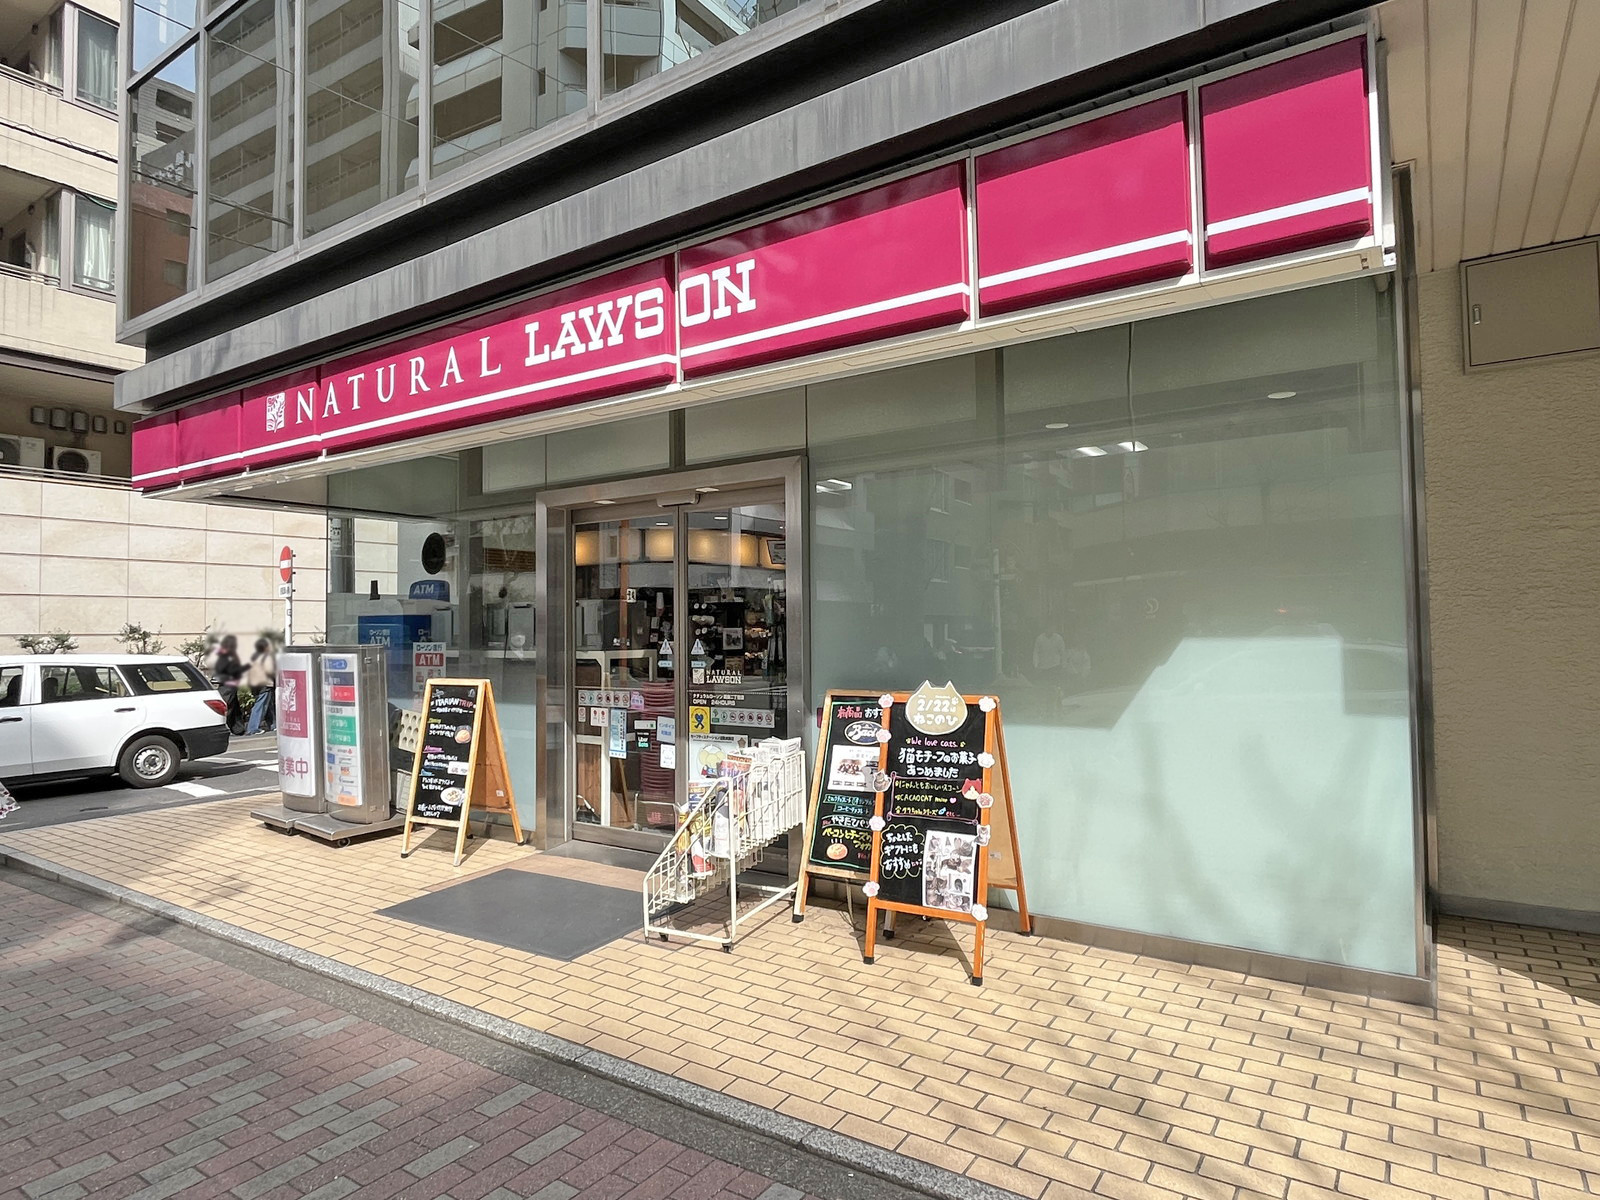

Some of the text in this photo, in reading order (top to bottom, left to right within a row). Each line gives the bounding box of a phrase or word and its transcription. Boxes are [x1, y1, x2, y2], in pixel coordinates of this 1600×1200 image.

[295, 259, 757, 425] NATURAL LAWSON
[413, 584, 435, 594] ATM
[369, 636, 391, 647] ATM
[418, 654, 441, 666] ATM
[706, 675, 742, 684] LAWSON
[913, 713, 959, 726] ねこのひ
[911, 736, 922, 745] We
[924, 737, 938, 747] love
[898, 747, 978, 765] 猫モチーフのお菓子
[906, 764, 959, 779] あつめました
[884, 842, 919, 857] ギフトにも
[882, 856, 912, 873] おすすめ
